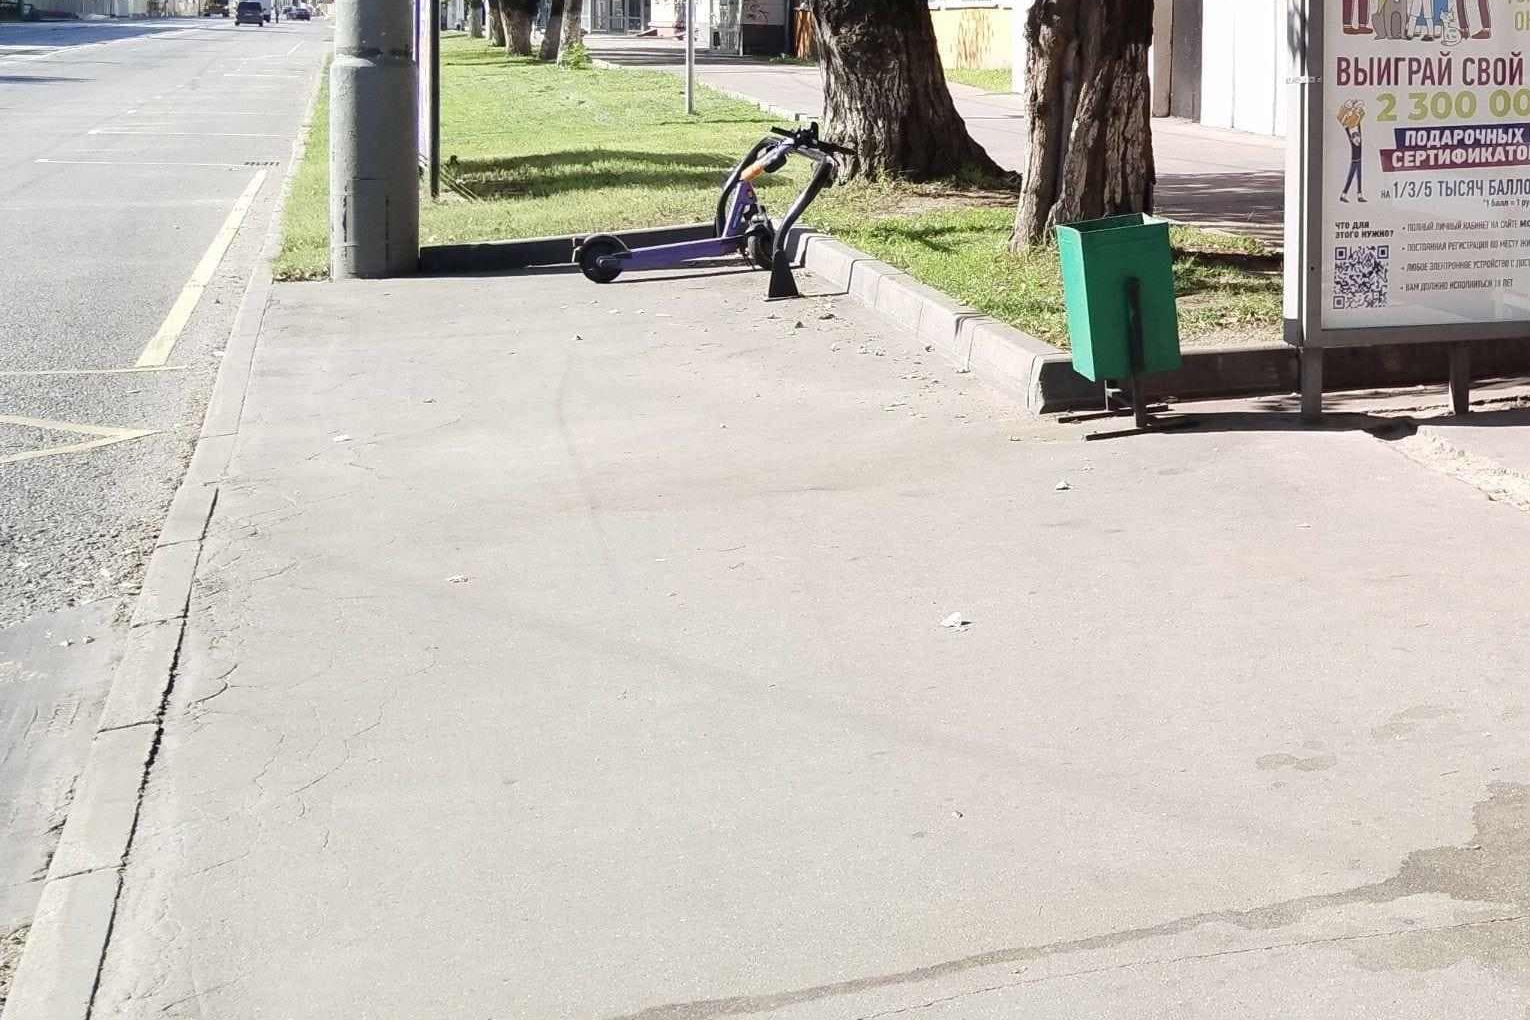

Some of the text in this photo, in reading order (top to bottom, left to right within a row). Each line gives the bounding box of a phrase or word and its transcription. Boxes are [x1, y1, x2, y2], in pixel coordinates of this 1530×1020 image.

[1336, 50, 1453, 87] ВЫИГРАЙ
[1461, 51, 1523, 87] СВОЙ
[1376, 92, 1398, 122] 2
[1407, 90, 1478, 122] 300
[1404, 127, 1525, 148] ПОДАРОЧНЫХ
[1393, 180, 1433, 198] 1/3/5
[1438, 179, 1484, 197] ТЫСЯЧ
[1335, 221, 1350, 230] ЧТО
[1335, 229, 1394, 239] ЭТОГО НУЖНО?
